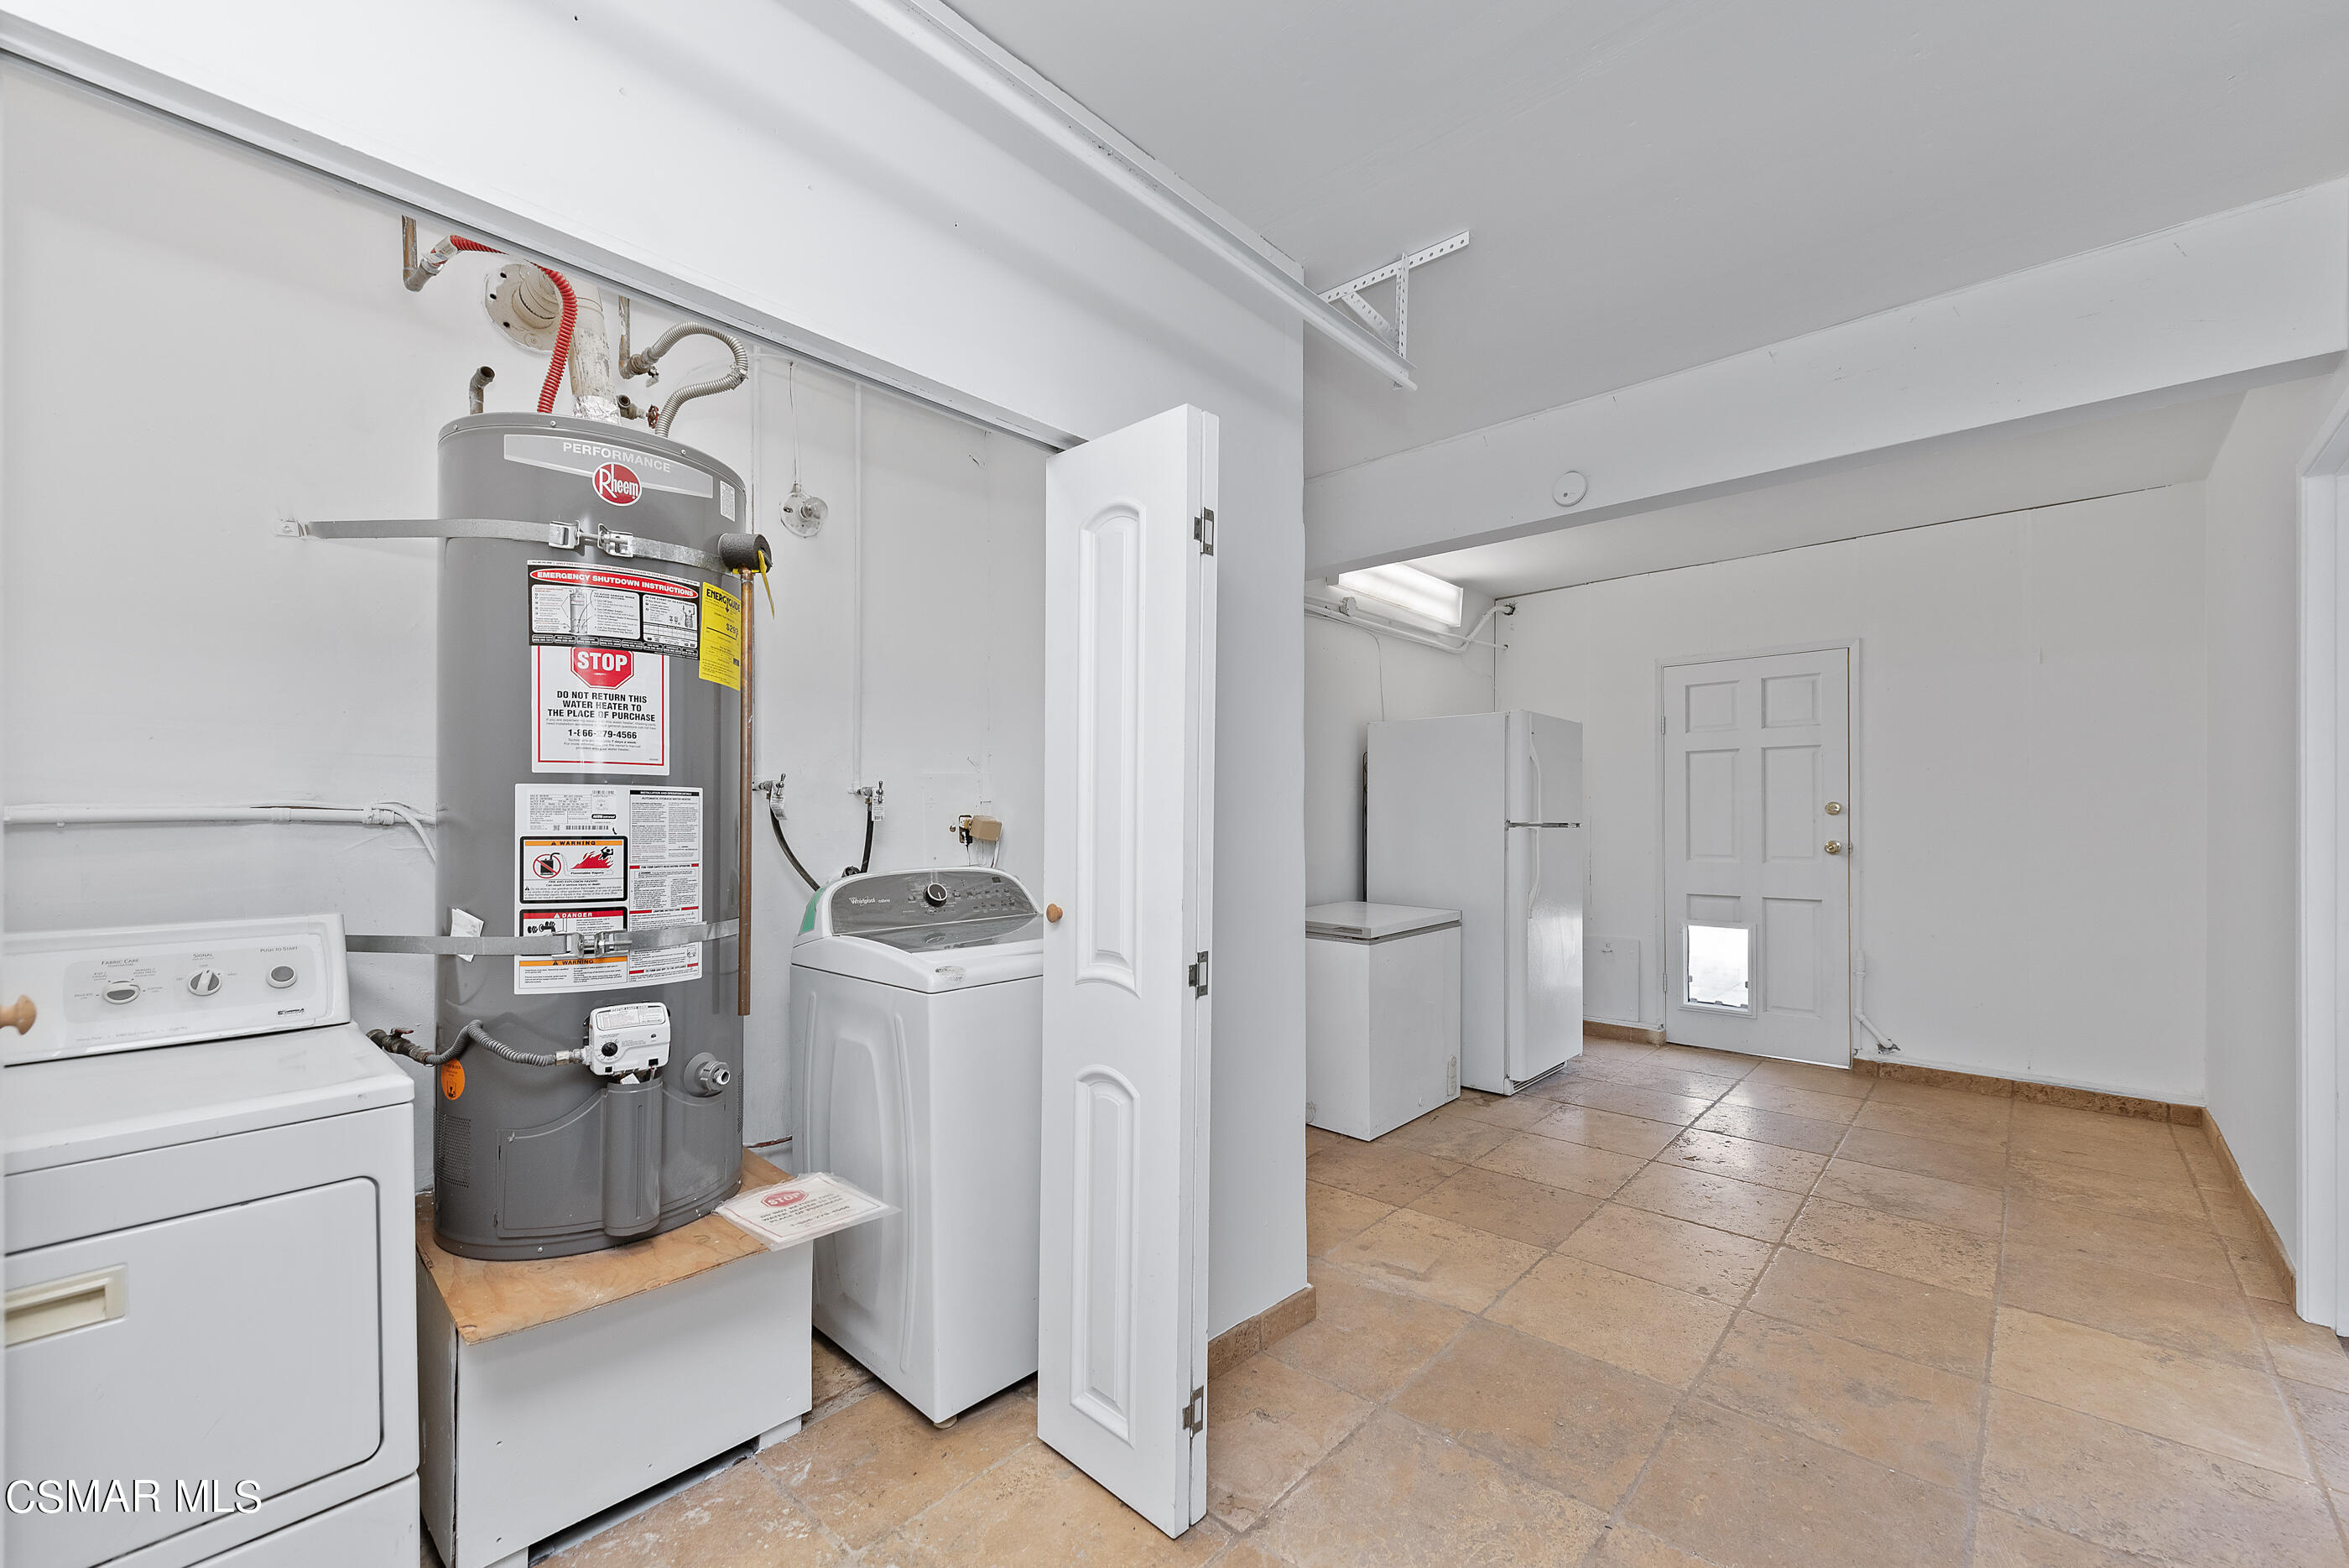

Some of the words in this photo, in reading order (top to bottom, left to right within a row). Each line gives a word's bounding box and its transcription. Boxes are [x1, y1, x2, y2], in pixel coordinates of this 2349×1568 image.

[563, 442, 671, 472] PERFORMANCE
[599, 464, 638, 499] Rheem
[537, 572, 591, 581] EMERGENCY
[592, 576, 640, 586] SHUTDOWN
[642, 581, 694, 596] INSTRUCTIONS
[577, 651, 628, 672] STOP
[557, 690, 569, 699] DO
[571, 691, 589, 700] NOT
[591, 692, 626, 702] RETURN
[628, 695, 647, 703] THIS
[563, 700, 593, 709] WATER
[596, 701, 628, 711] HEATER
[631, 704, 642, 712] TO
[567, 709, 595, 718] PLACE
[597, 711, 609, 719] OF
[612, 711, 655, 721] PURCHASE
[849, 896, 875, 906] Whirlpool
[767, 1192, 800, 1205] STOP
